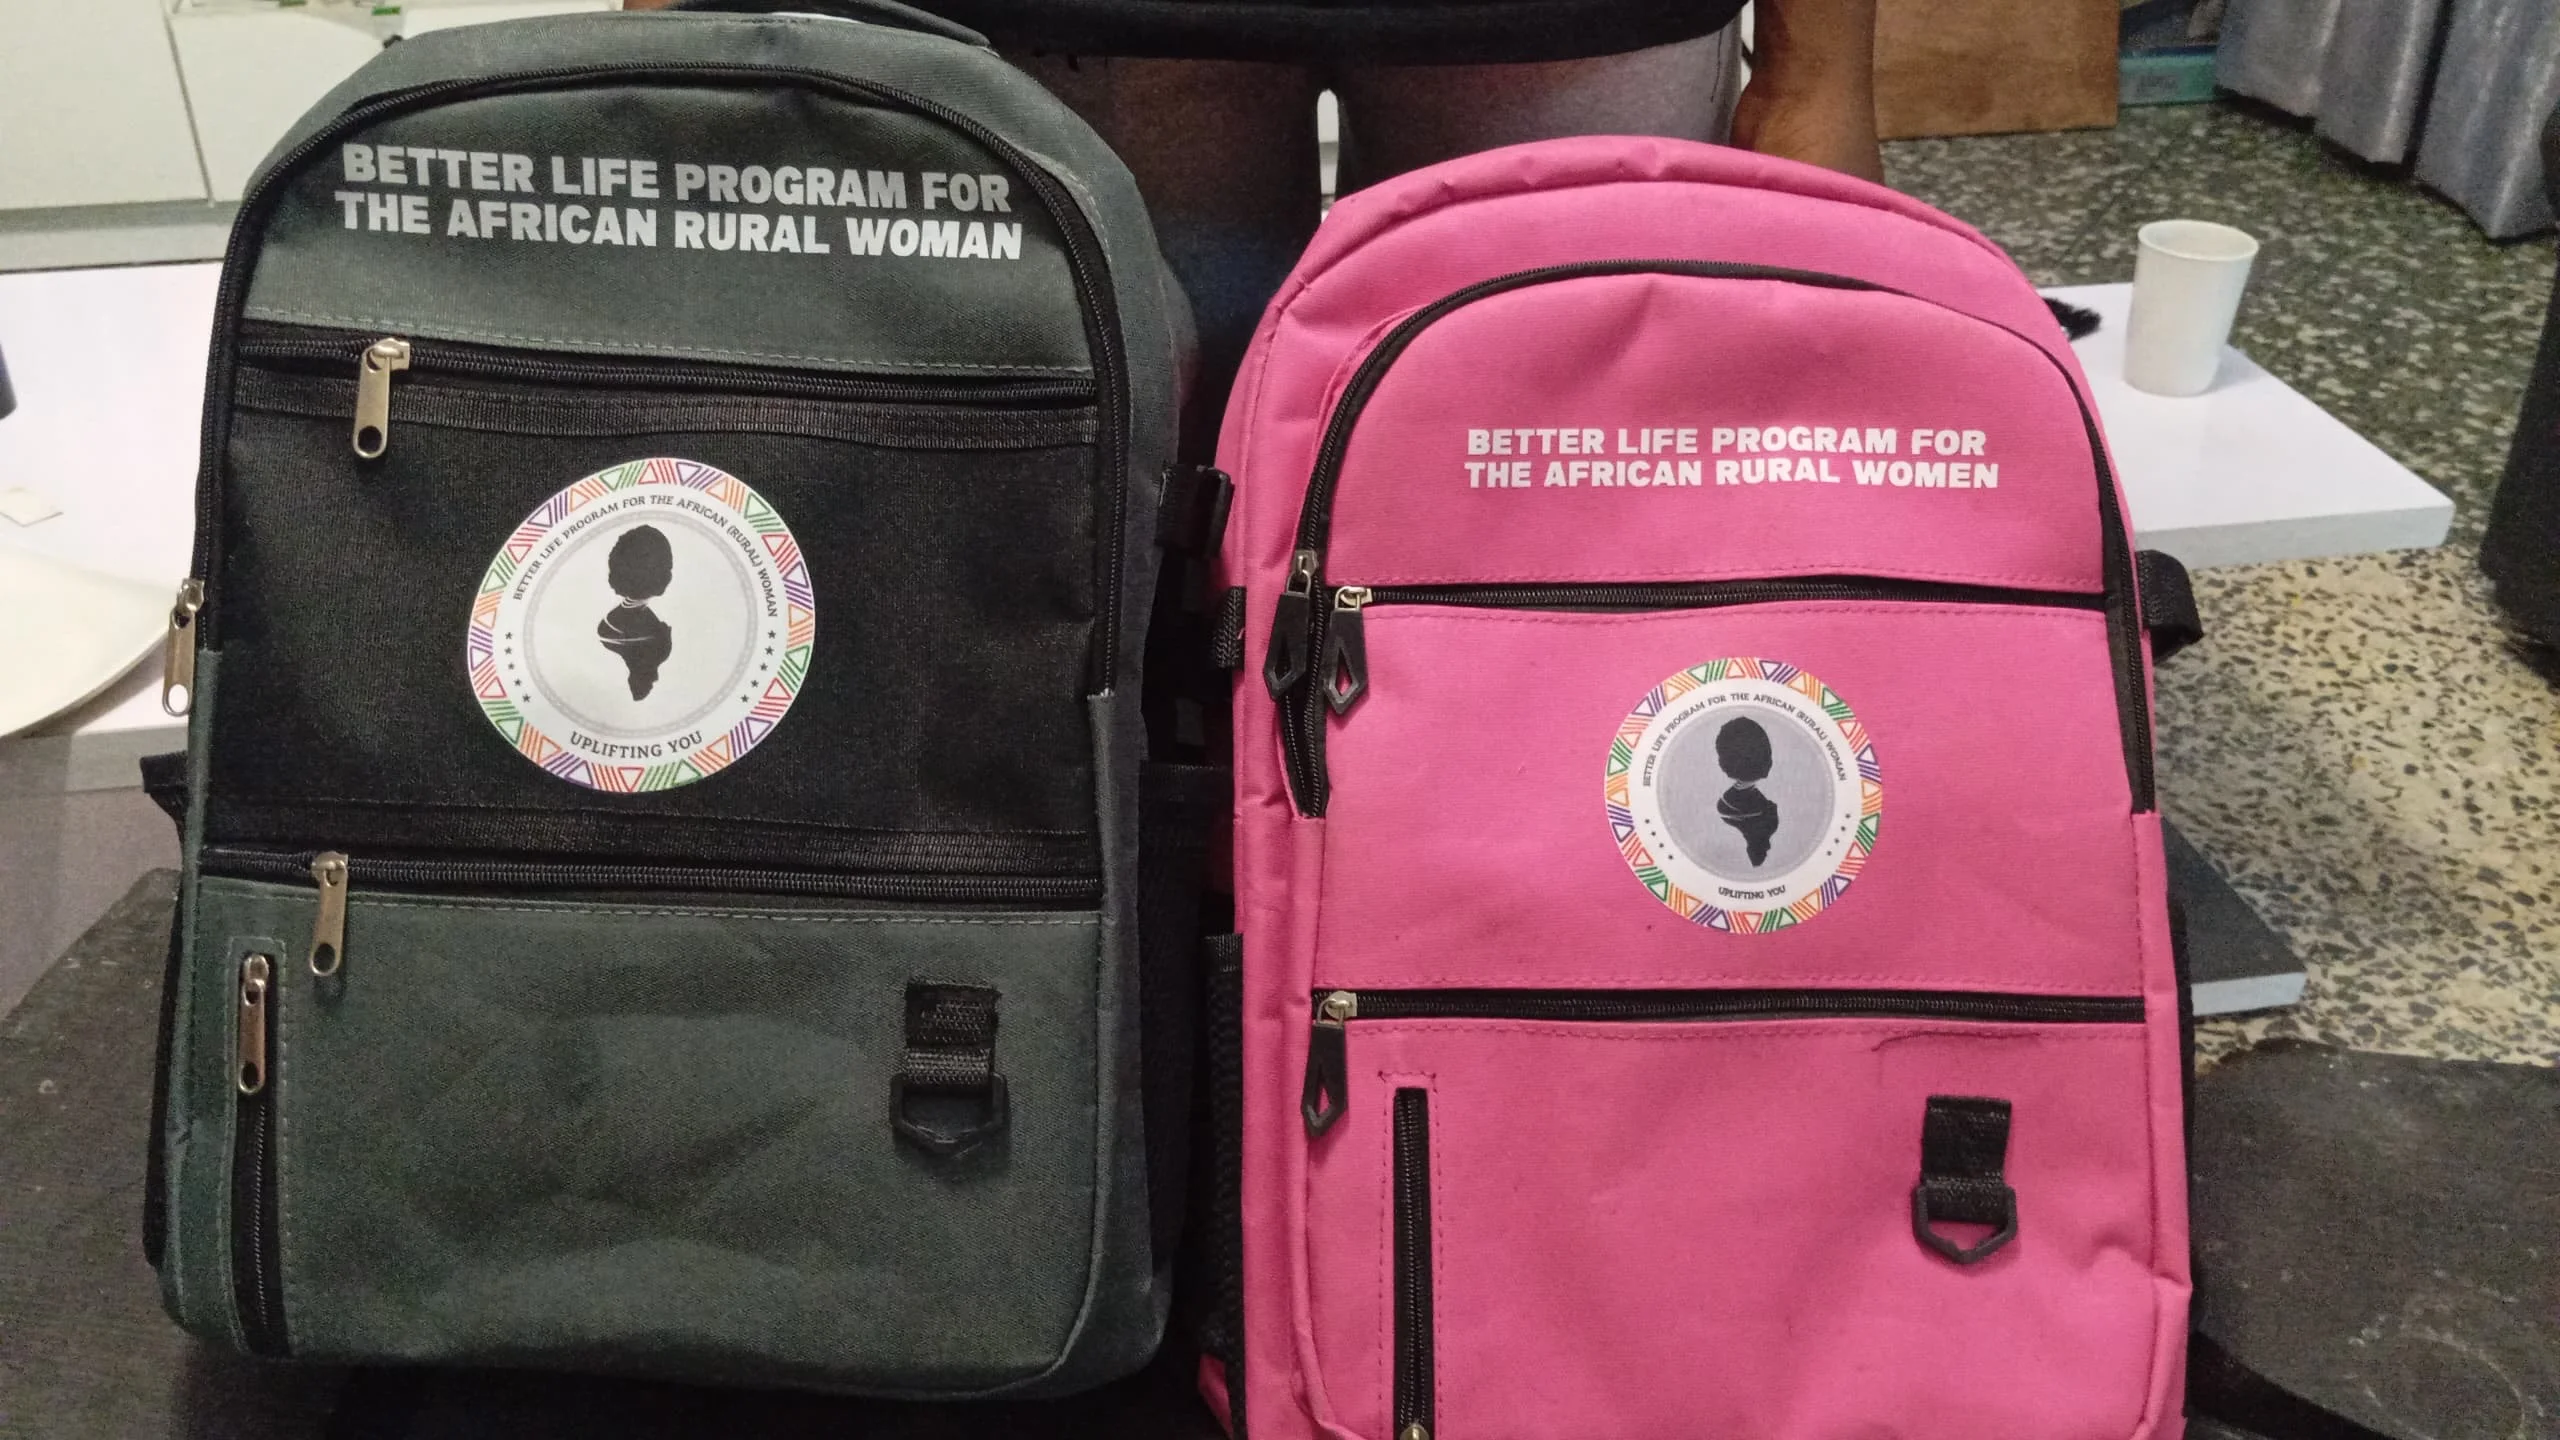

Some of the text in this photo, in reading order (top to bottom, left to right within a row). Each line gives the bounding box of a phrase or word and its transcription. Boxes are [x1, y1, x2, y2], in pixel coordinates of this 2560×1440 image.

[344, 144, 1011, 213] BETTER LIFE PROGRAM FOR
[335, 191, 1022, 259] THE AFRICAN RURAL WOMAN
[1468, 427, 1985, 456] BETTER LIFE PROGRAM FOR
[1465, 457, 1998, 489] THE AFRICAN RURAL WOMEN
[514, 495, 778, 617] BETTER LIFE PROGRAM FOR THE AFRICAN (RURAL) WOMAN
[570, 731, 702, 759] UPLIFTING YOU
[1643, 754, 1656, 786] BETTER
[1652, 733, 1667, 751] LIFE
[1665, 701, 1705, 733] PROGRAM
[1707, 695, 1727, 706] FOR
[1731, 693, 1749, 701] THE
[1753, 694, 1795, 713] AFRICAN
[1826, 741, 1847, 781] WOMAN
[1718, 884, 1785, 899] UPLIFTING YOU
